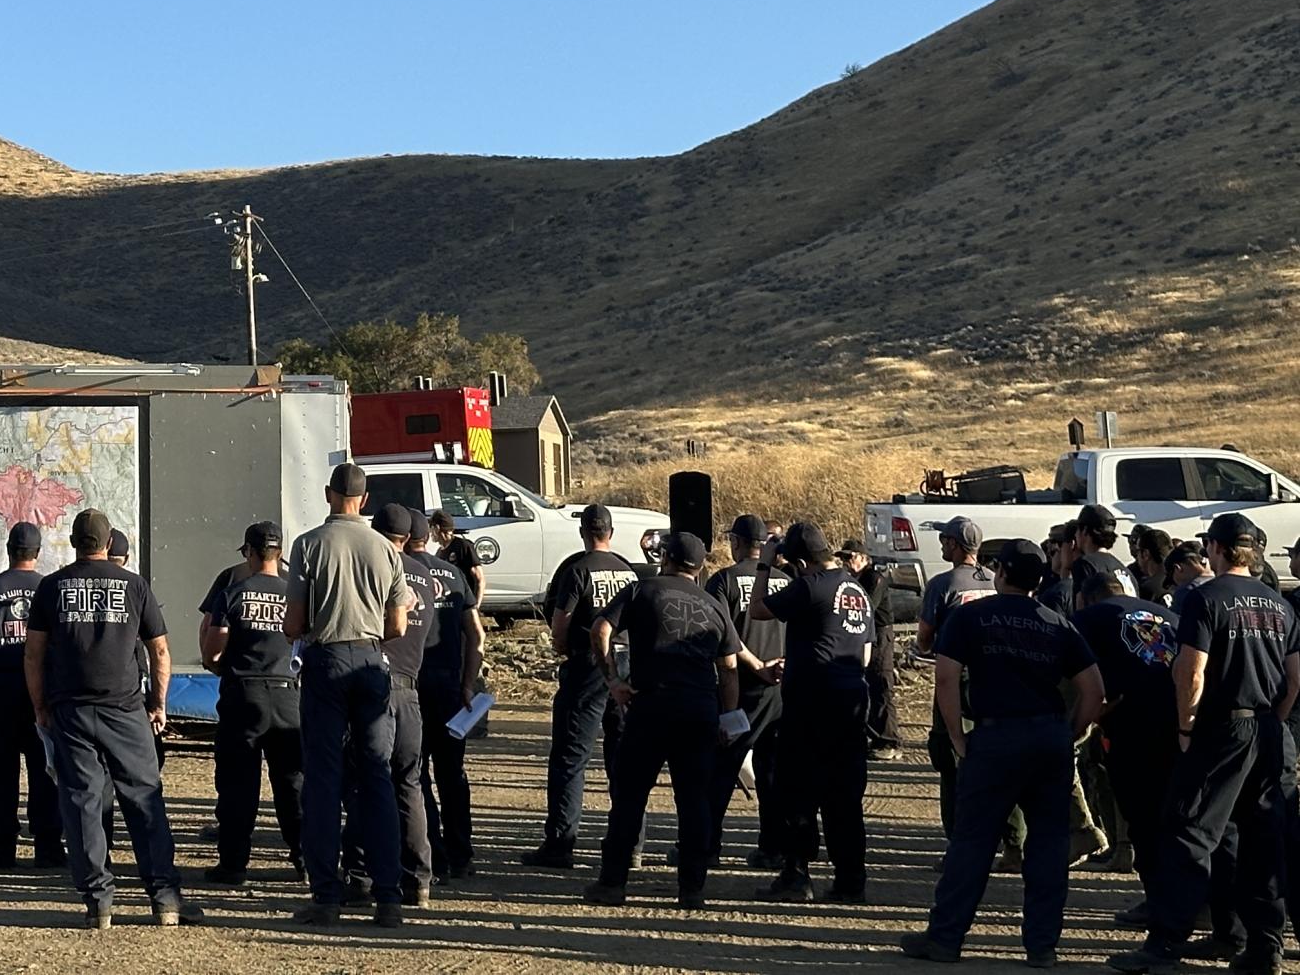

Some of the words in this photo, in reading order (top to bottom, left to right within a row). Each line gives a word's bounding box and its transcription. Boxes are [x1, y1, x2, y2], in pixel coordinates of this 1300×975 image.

[86, 578, 129, 589] COUNTY
[7, 589, 23, 598] LUIS
[61, 588, 126, 613] FIRE
[59, 611, 129, 623] DEPARTMENT
[847, 610, 863, 622] 501
